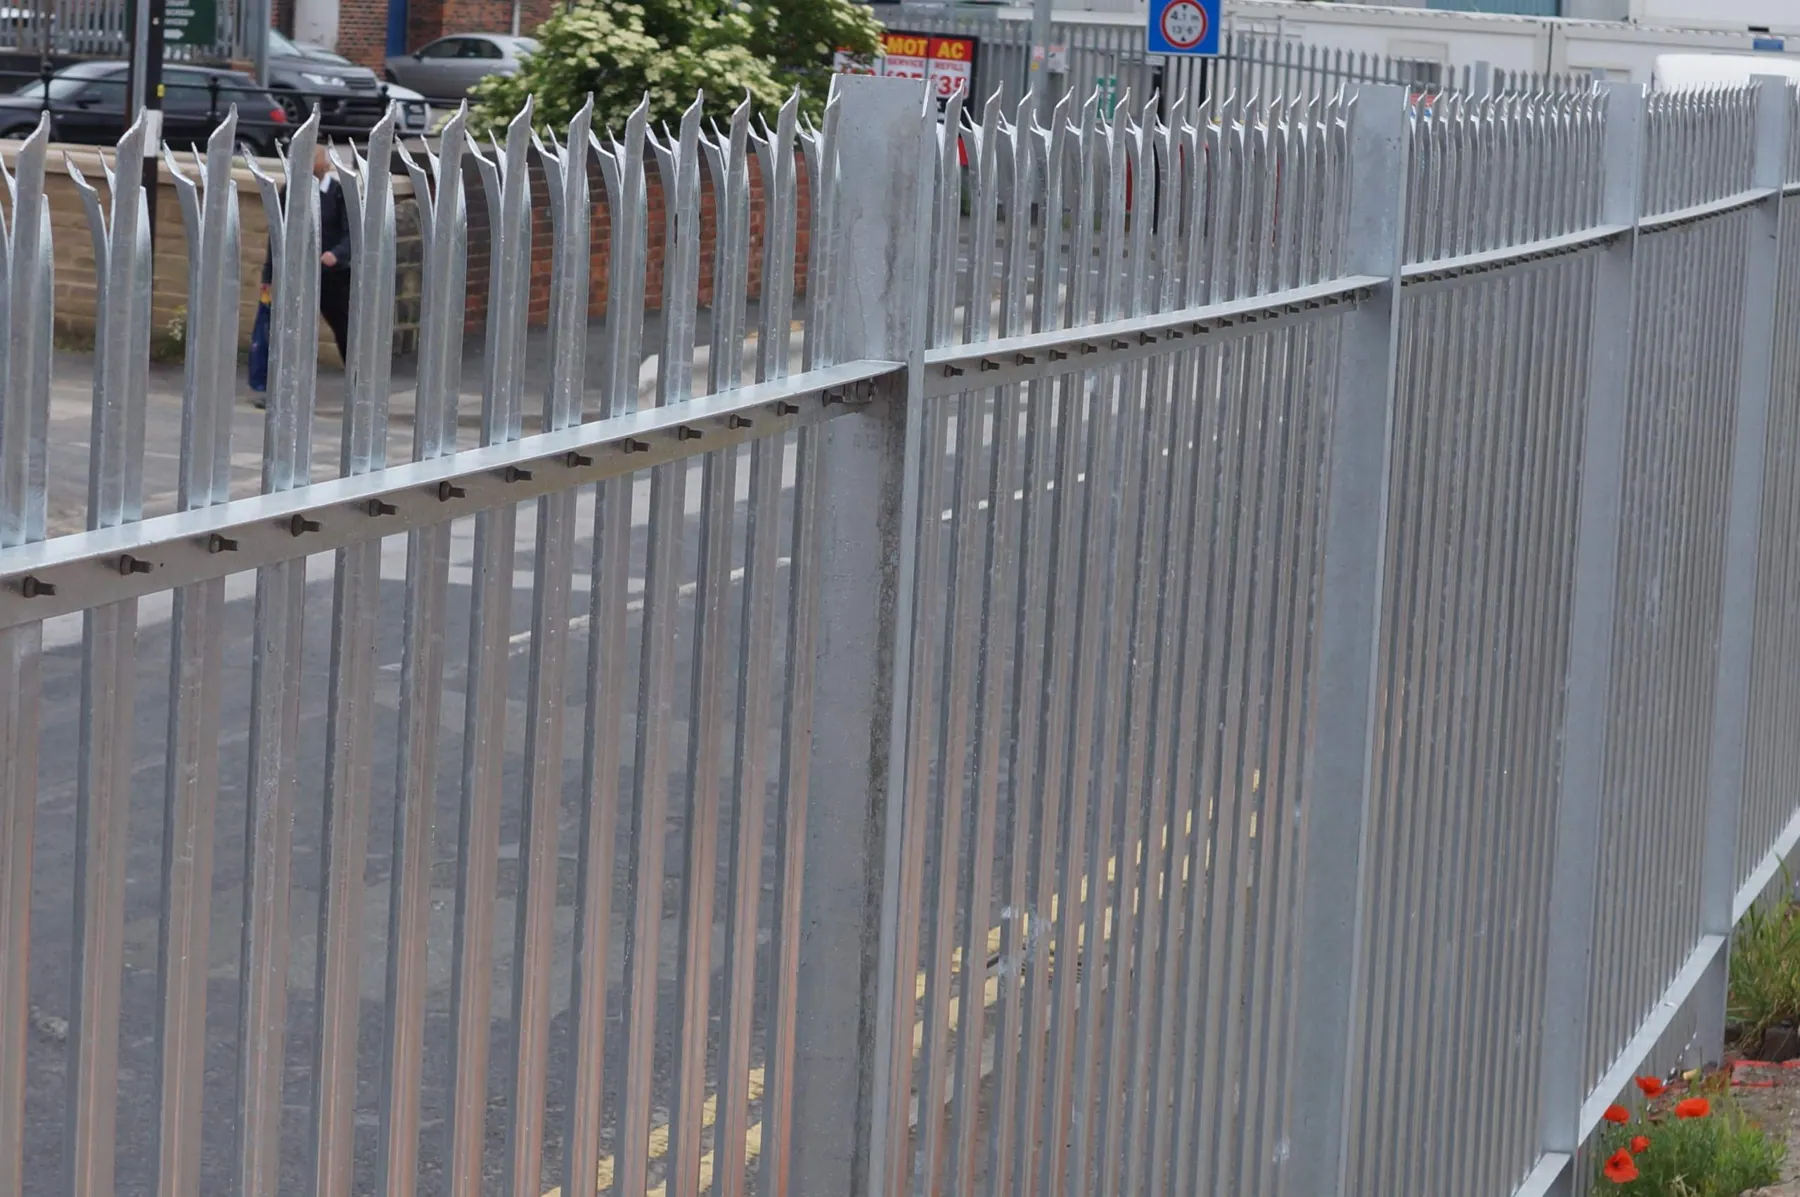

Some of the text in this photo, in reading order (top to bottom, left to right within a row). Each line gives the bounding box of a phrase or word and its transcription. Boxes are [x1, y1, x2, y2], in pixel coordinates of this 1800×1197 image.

[887, 37, 928, 56] MOT
[937, 41, 964, 59] AC
[888, 57, 924, 68] SERVICE
[934, 62, 964, 72] REFILL
